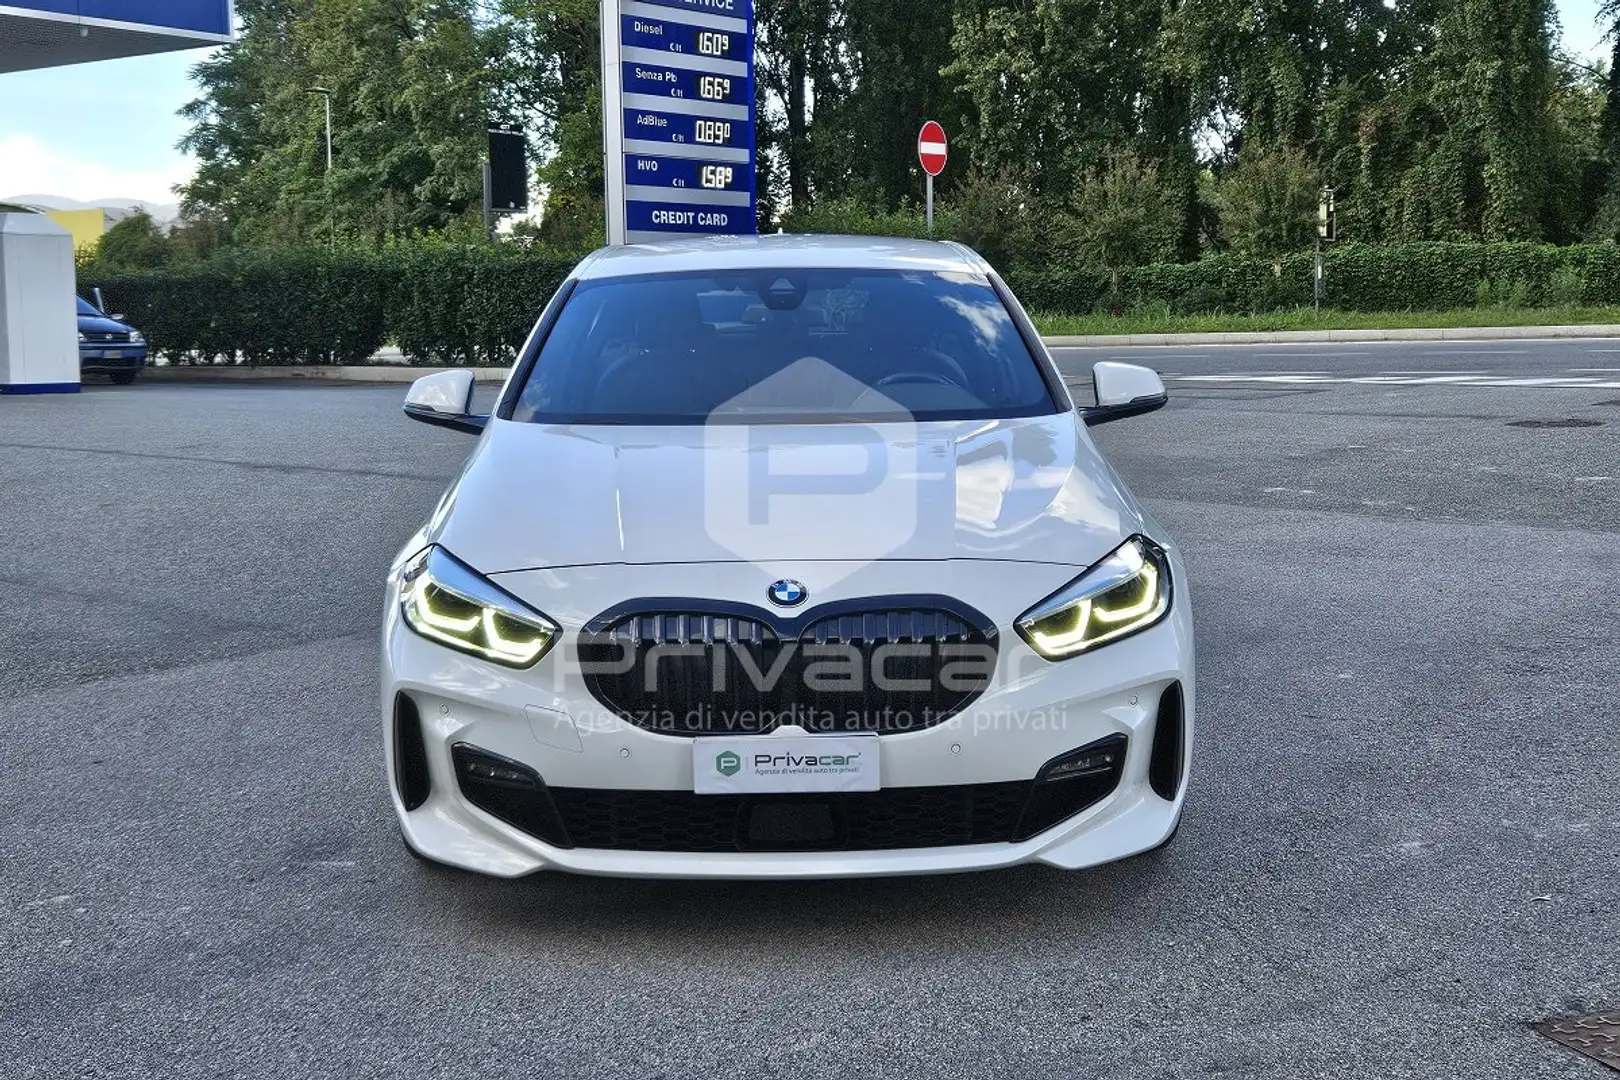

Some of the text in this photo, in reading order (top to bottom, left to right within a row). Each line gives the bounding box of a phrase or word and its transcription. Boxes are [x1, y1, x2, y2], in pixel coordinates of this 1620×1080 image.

[634, 21, 663, 35] Diesel
[635, 68, 678, 83] Senza Pb
[637, 114, 668, 127] AdBlue
[637, 160, 658, 171] HVO
[652, 210, 728, 226] CREDIT CARD
[755, 752, 860, 767] Privacar
